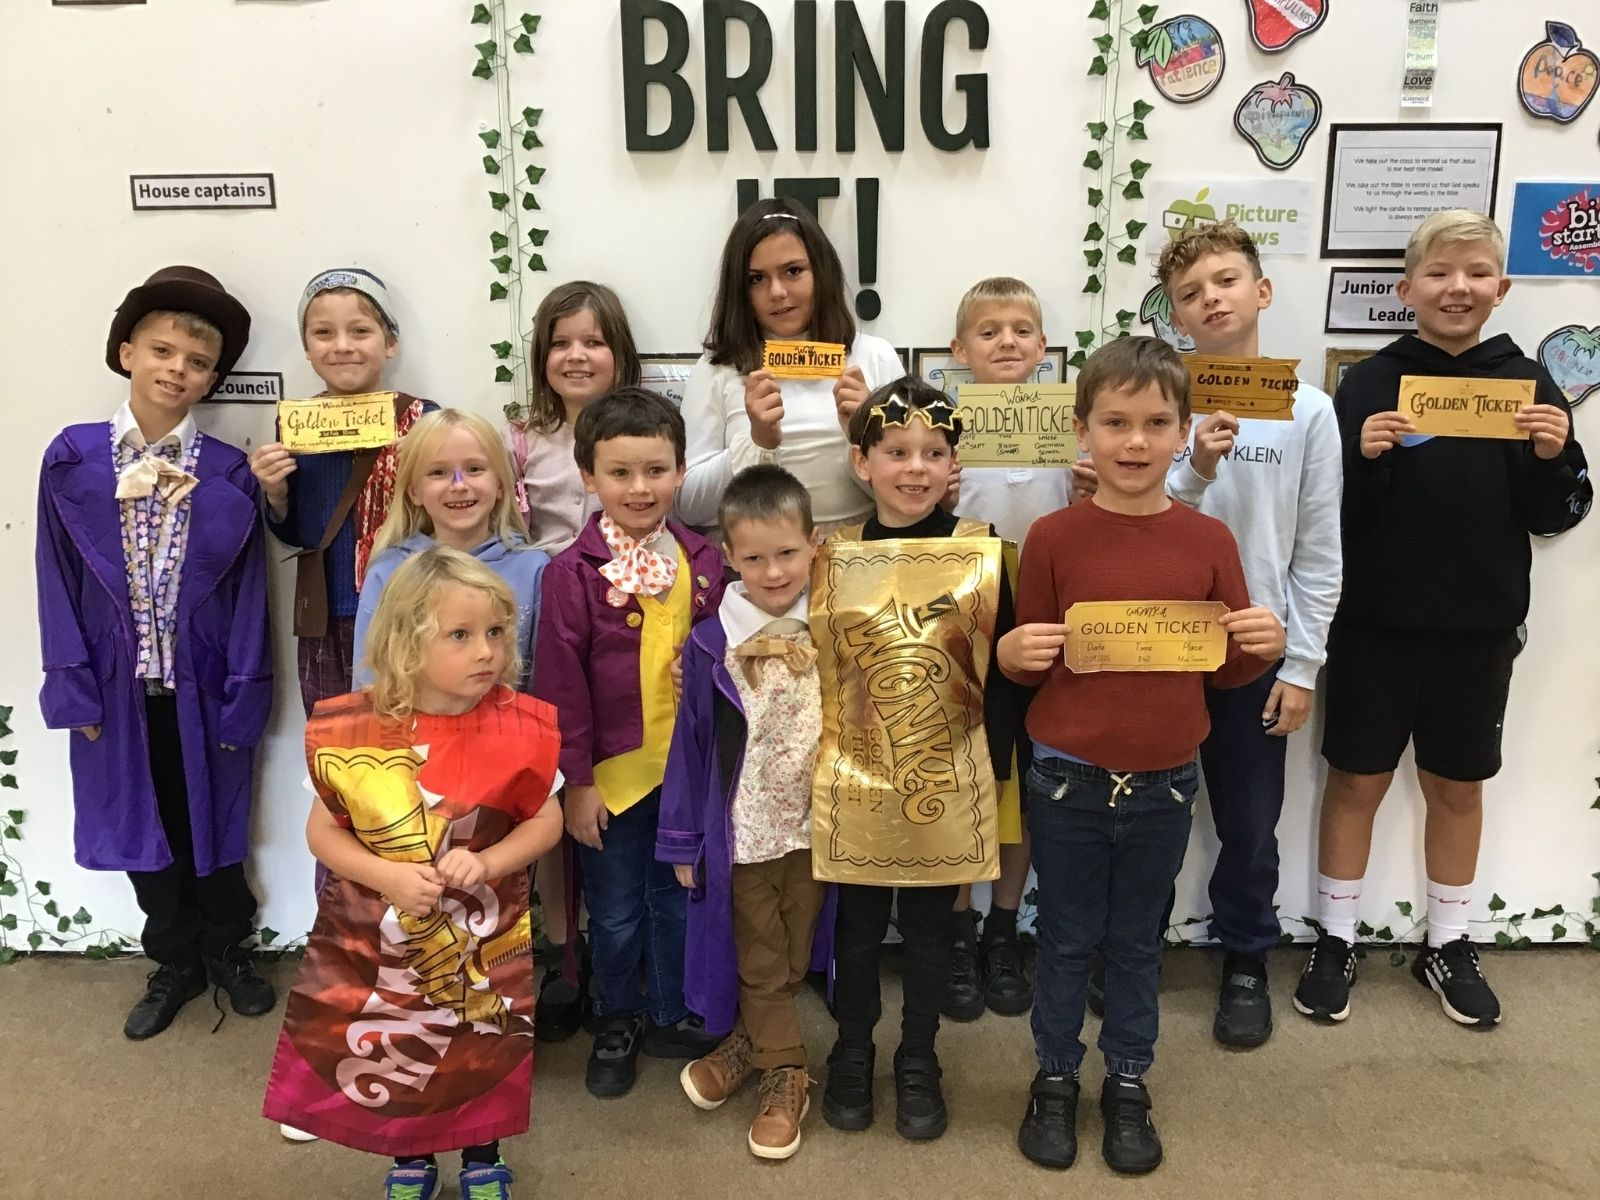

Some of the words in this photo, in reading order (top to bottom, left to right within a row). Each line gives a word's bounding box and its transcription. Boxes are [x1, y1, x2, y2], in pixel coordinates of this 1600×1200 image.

[1409, 2, 1438, 13] Faith
[620, 0, 991, 152] BRING
[1403, 75, 1433, 86] Love
[139, 184, 190, 199] House
[194, 182, 266, 202] captains
[1225, 203, 1299, 223] Picture
[1568, 200, 1600, 229] bi
[1250, 231, 1280, 246] ws
[1340, 280, 1394, 295] Junior
[1368, 306, 1416, 322] Leade
[768, 352, 806, 366] GOLDEN
[808, 353, 843, 366] TICKET
[1196, 373, 1250, 386] GOLDEN
[1260, 378, 1299, 391] TICKET
[287, 410, 340, 436] Golden
[342, 406, 390, 428] Ticket
[960, 405, 1024, 434] GOLDEN
[1233, 445, 1283, 465] KLEIN
[1081, 621, 1148, 635] GOLDEN
[1154, 620, 1212, 634] TICKET
[1086, 642, 1105, 652] Date
[844, 597, 960, 825] WONKA
